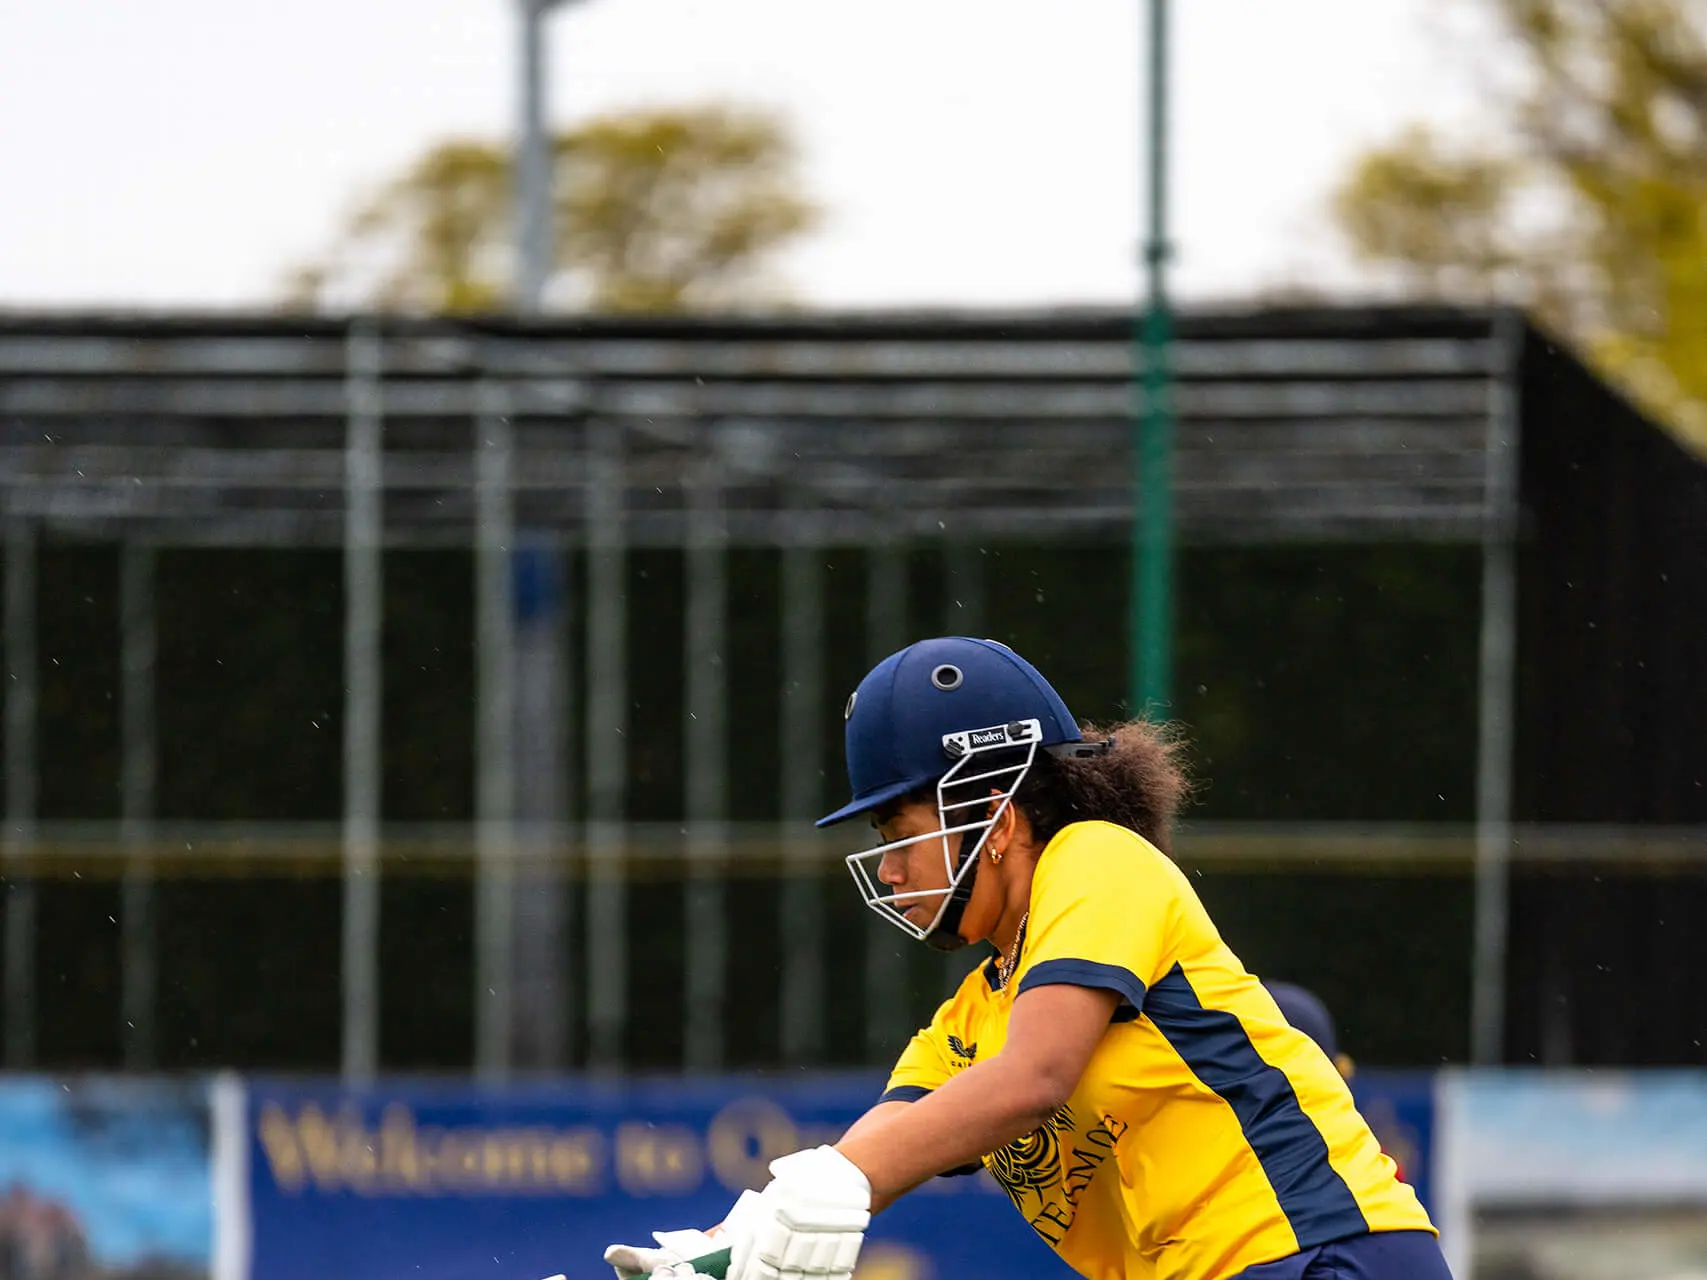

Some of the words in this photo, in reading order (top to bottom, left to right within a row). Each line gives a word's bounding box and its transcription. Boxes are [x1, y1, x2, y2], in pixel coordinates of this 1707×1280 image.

[972, 731, 1005, 745] Readers
[258, 1098, 606, 1196] Welcome
[614, 1118, 704, 1196] to
